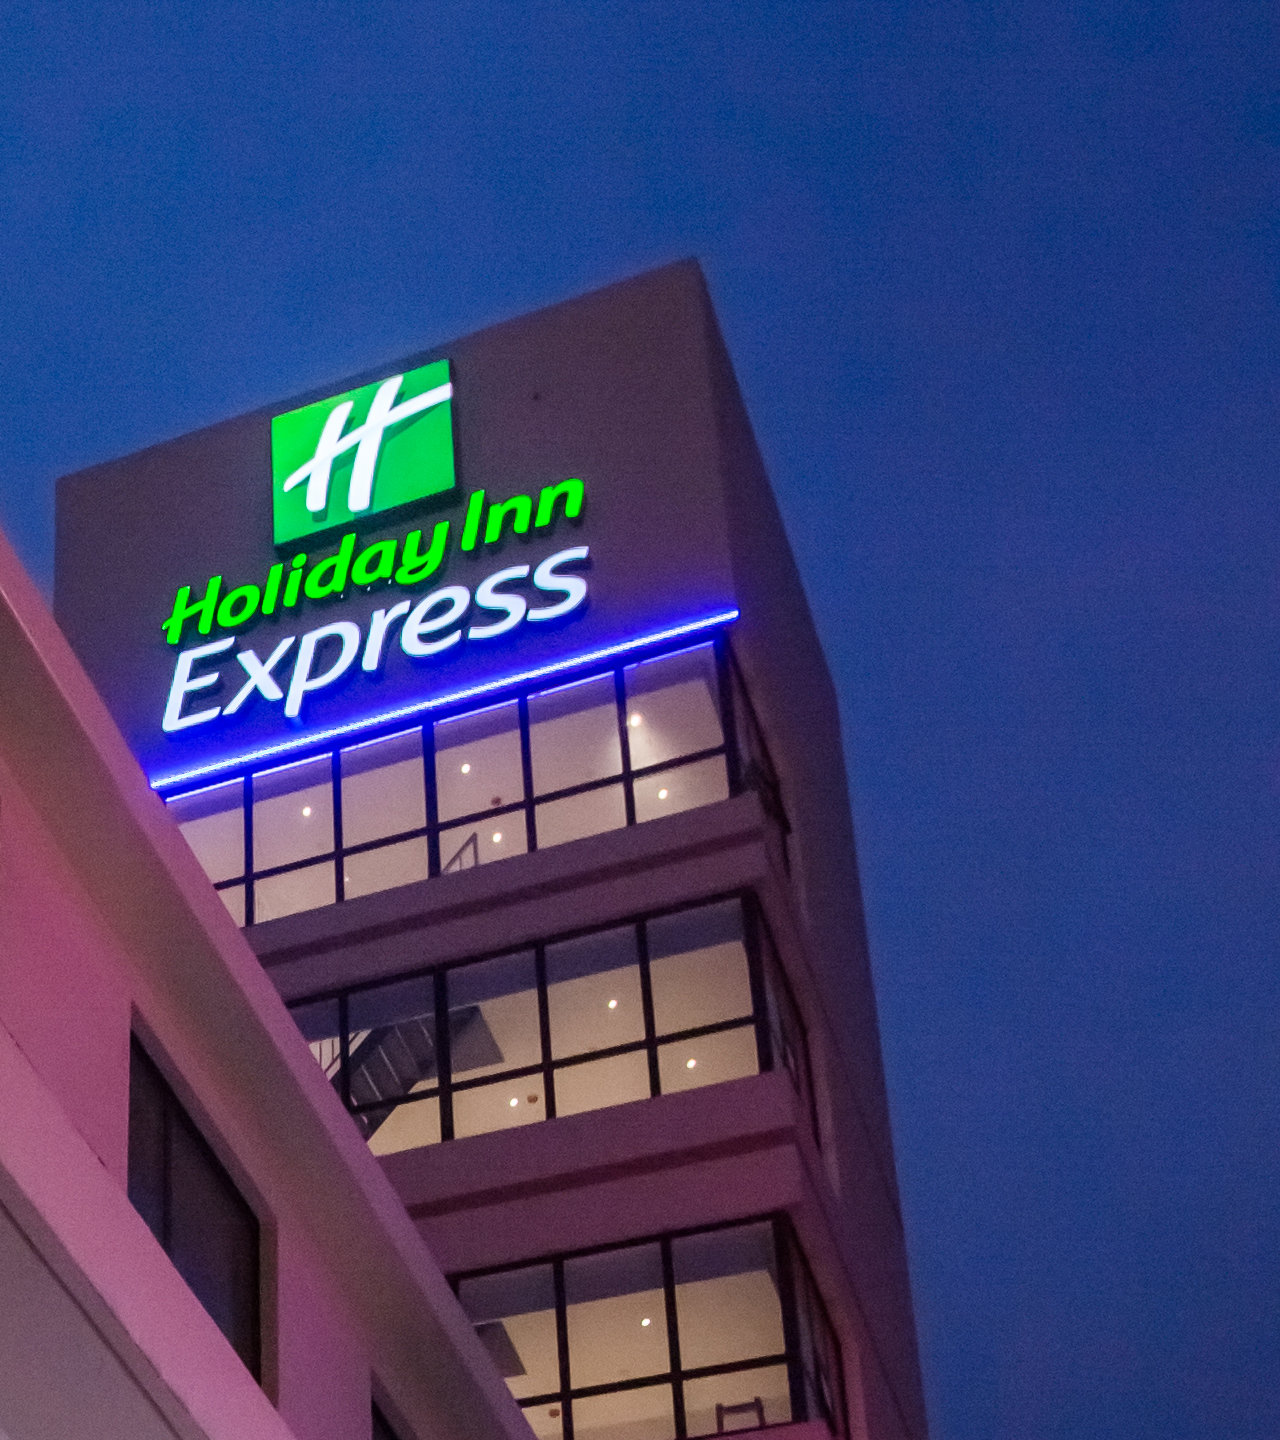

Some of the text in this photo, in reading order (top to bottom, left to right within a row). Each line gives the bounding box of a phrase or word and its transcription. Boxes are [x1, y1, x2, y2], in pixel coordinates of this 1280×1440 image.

[161, 478, 585, 646] Holiday Inn
[162, 546, 589, 732] Express
